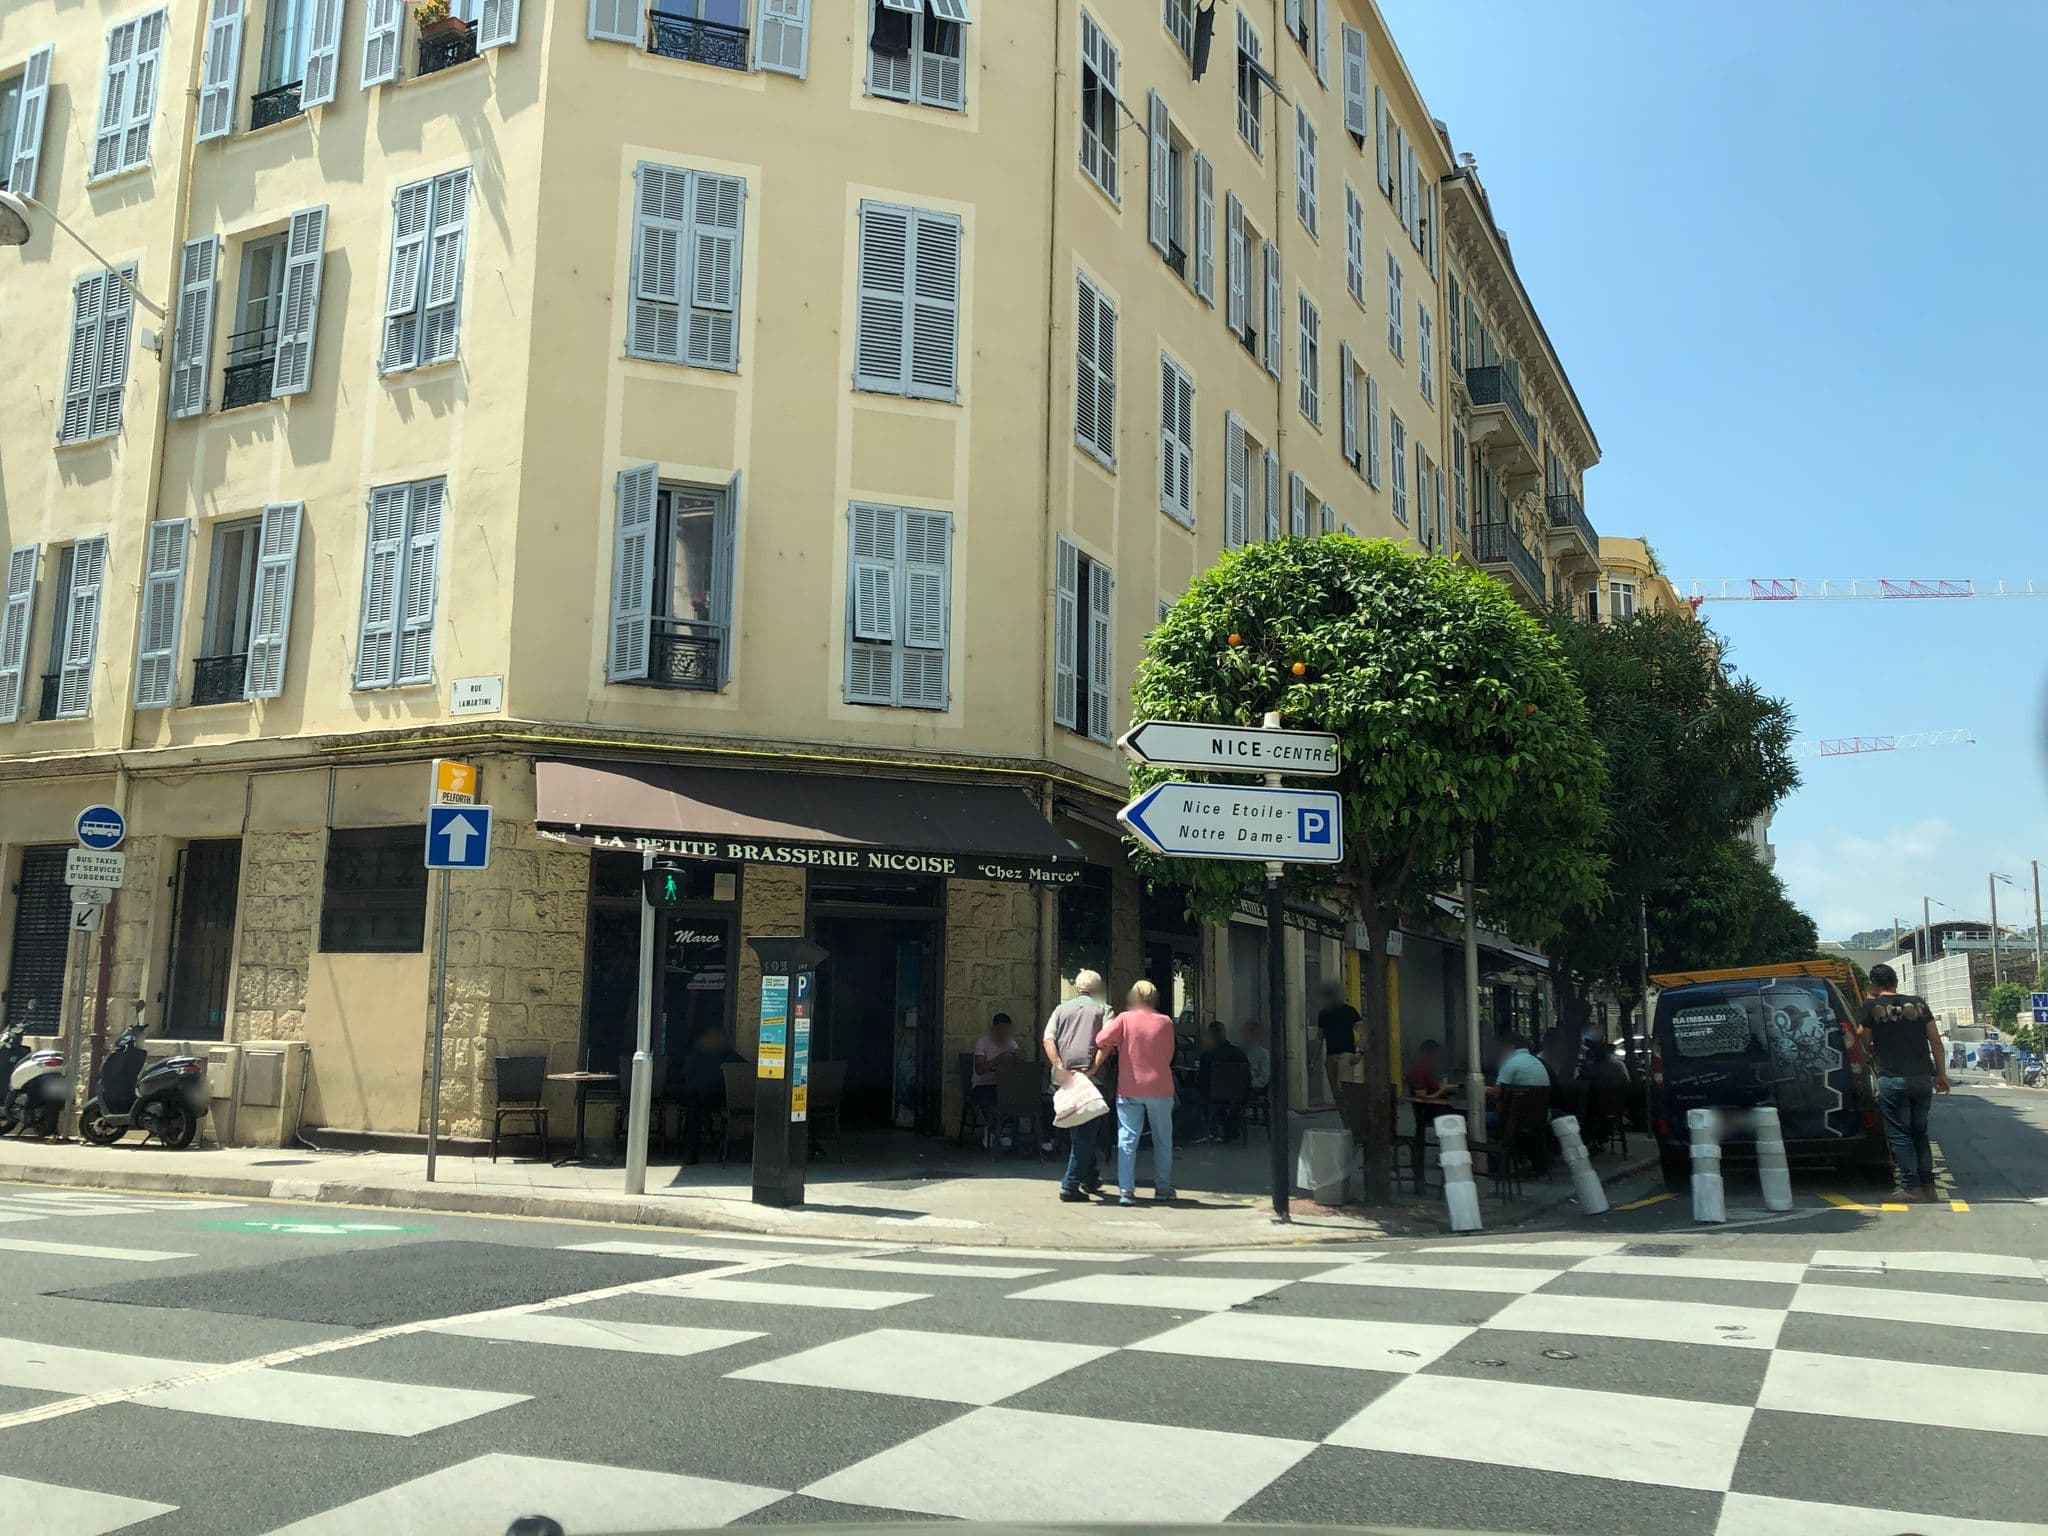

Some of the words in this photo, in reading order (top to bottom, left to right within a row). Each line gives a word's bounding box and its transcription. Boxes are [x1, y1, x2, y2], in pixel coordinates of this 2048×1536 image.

[442, 792, 472, 804] PELFORTH
[1183, 800, 1221, 815] Nice
[1303, 812, 1325, 841] P
[1179, 825, 1226, 840] Notre
[594, 834, 626, 848] LA
[634, 837, 718, 857] PETITE
[726, 843, 860, 868] BRASSERIE
[95, 857, 118, 865] TAXIS
[83, 865, 122, 874] SERVICES
[70, 872, 120, 882] D'URGENCES
[674, 930, 721, 943] Marco
[764, 960, 788, 971] 102
[1672, 1014, 1726, 1024] RAIMBALDI
